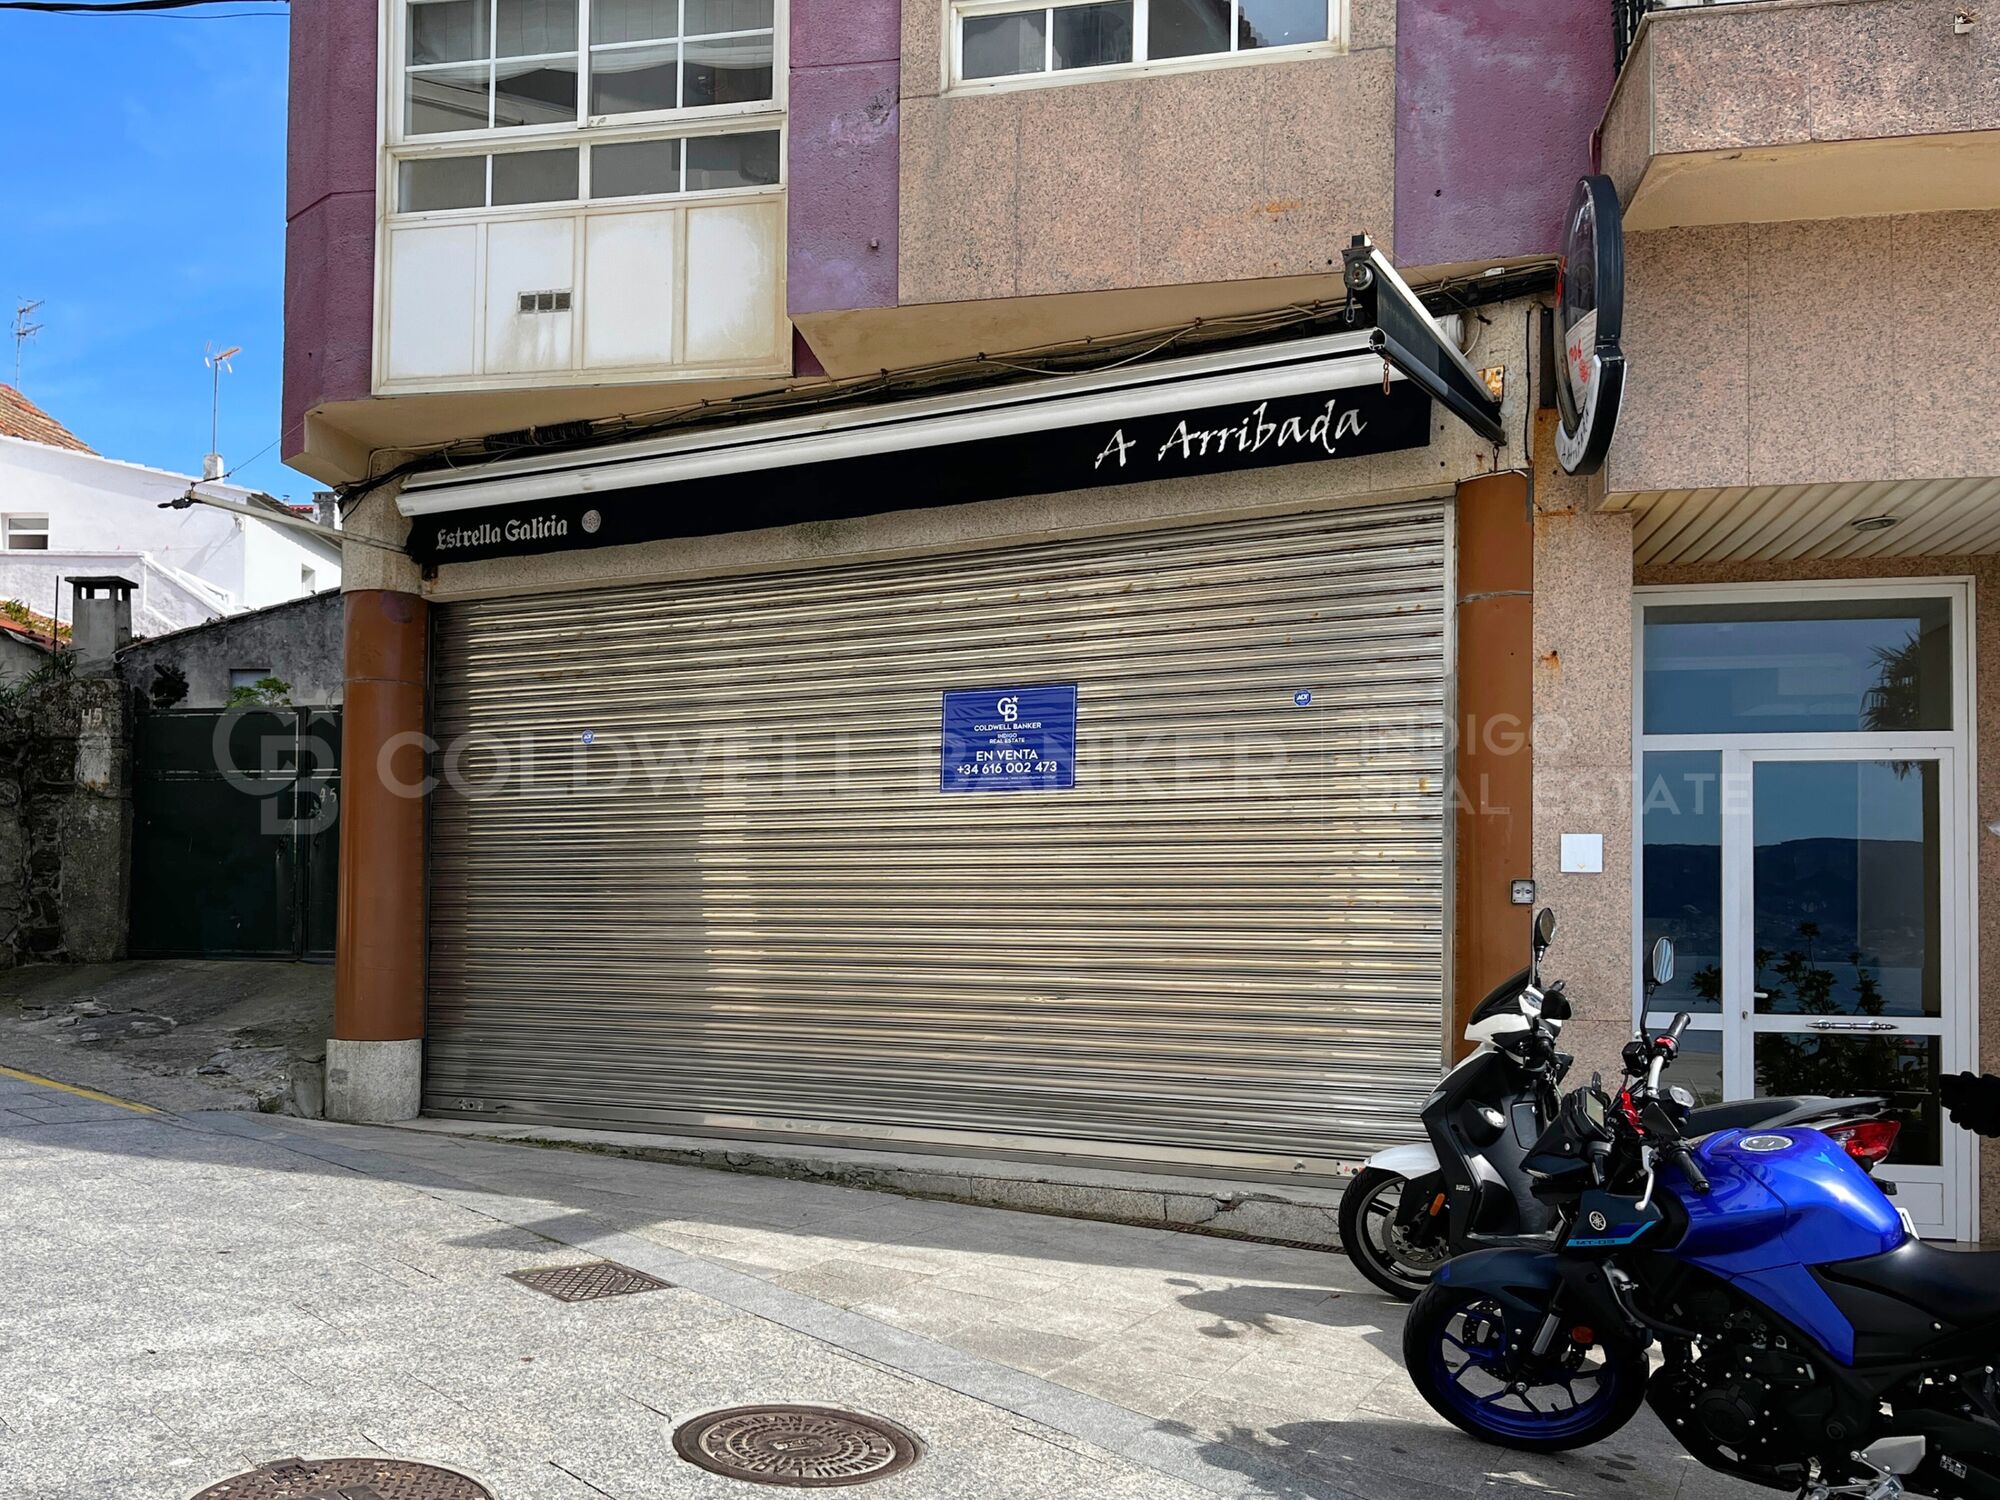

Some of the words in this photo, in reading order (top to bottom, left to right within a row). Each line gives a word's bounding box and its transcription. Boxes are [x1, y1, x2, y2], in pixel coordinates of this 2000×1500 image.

[1094, 428, 1137, 470] A
[1157, 399, 1369, 462] Arribada
[436, 523, 502, 551] Estrella
[504, 514, 569, 542] Galicia
[997, 697, 1018, 722] CB
[974, 723, 1011, 732] COLDWELL
[1013, 722, 1042, 730] BANKER
[976, 750, 993, 762] EN
[996, 749, 1039, 761] VENTA
[957, 763, 979, 775] +34
[981, 762, 1003, 774] 616
[1005, 761, 1032, 773] 002
[1034, 761, 1058, 772] 473
[1455, 1183, 1471, 1192] 125
[1575, 1238, 1616, 1246] MT-03
